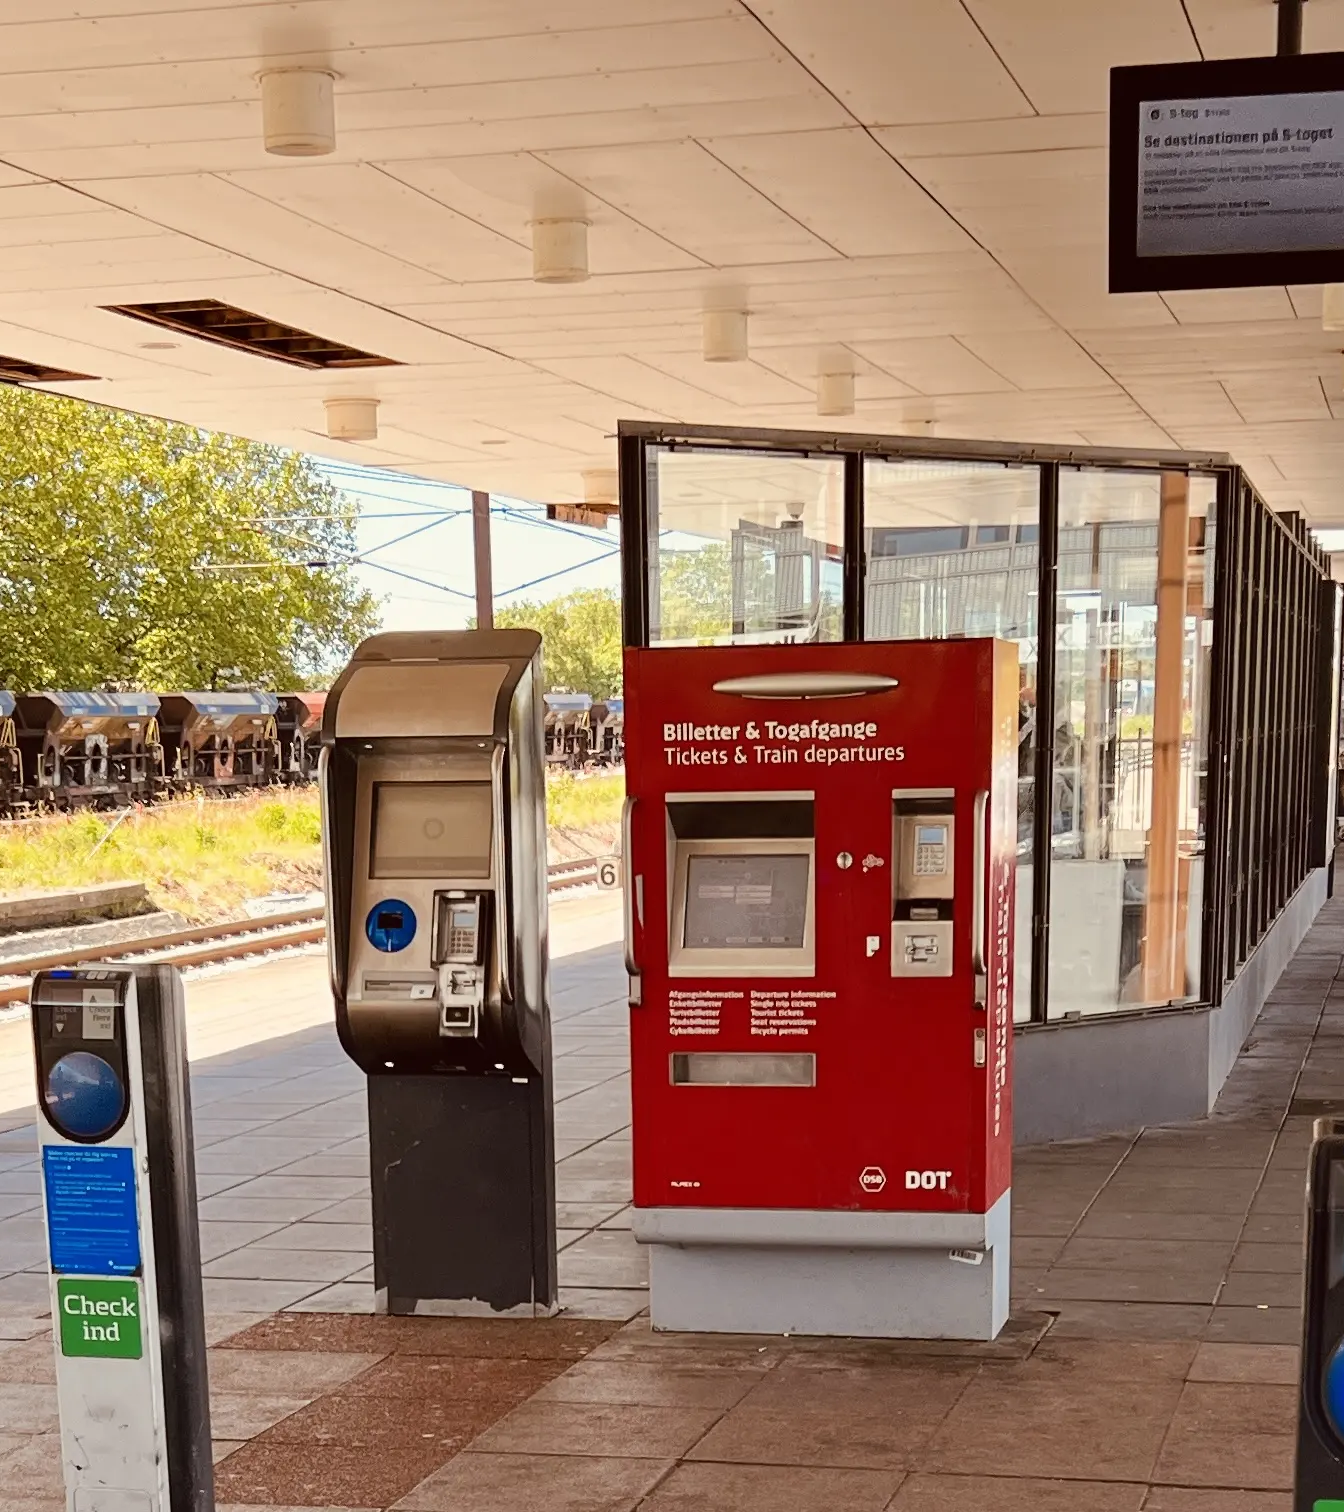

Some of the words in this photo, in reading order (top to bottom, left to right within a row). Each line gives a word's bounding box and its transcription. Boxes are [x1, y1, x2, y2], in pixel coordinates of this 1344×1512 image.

[1144, 135, 1160, 148] Se
[1164, 131, 1258, 147] destinationen
[1263, 128, 1279, 144] på
[663, 722, 740, 741] Billetter
[745, 721, 761, 740] &
[764, 720, 877, 742] Togafgange
[663, 746, 728, 765] Tickets
[734, 746, 748, 764] &
[753, 745, 798, 764] Train
[804, 744, 905, 766] departures
[600, 863, 616, 886] 6
[863, 1175, 883, 1184] DSB
[905, 1171, 952, 1190] DOT
[64, 1294, 136, 1316] Check
[83, 1320, 120, 1341] ind
